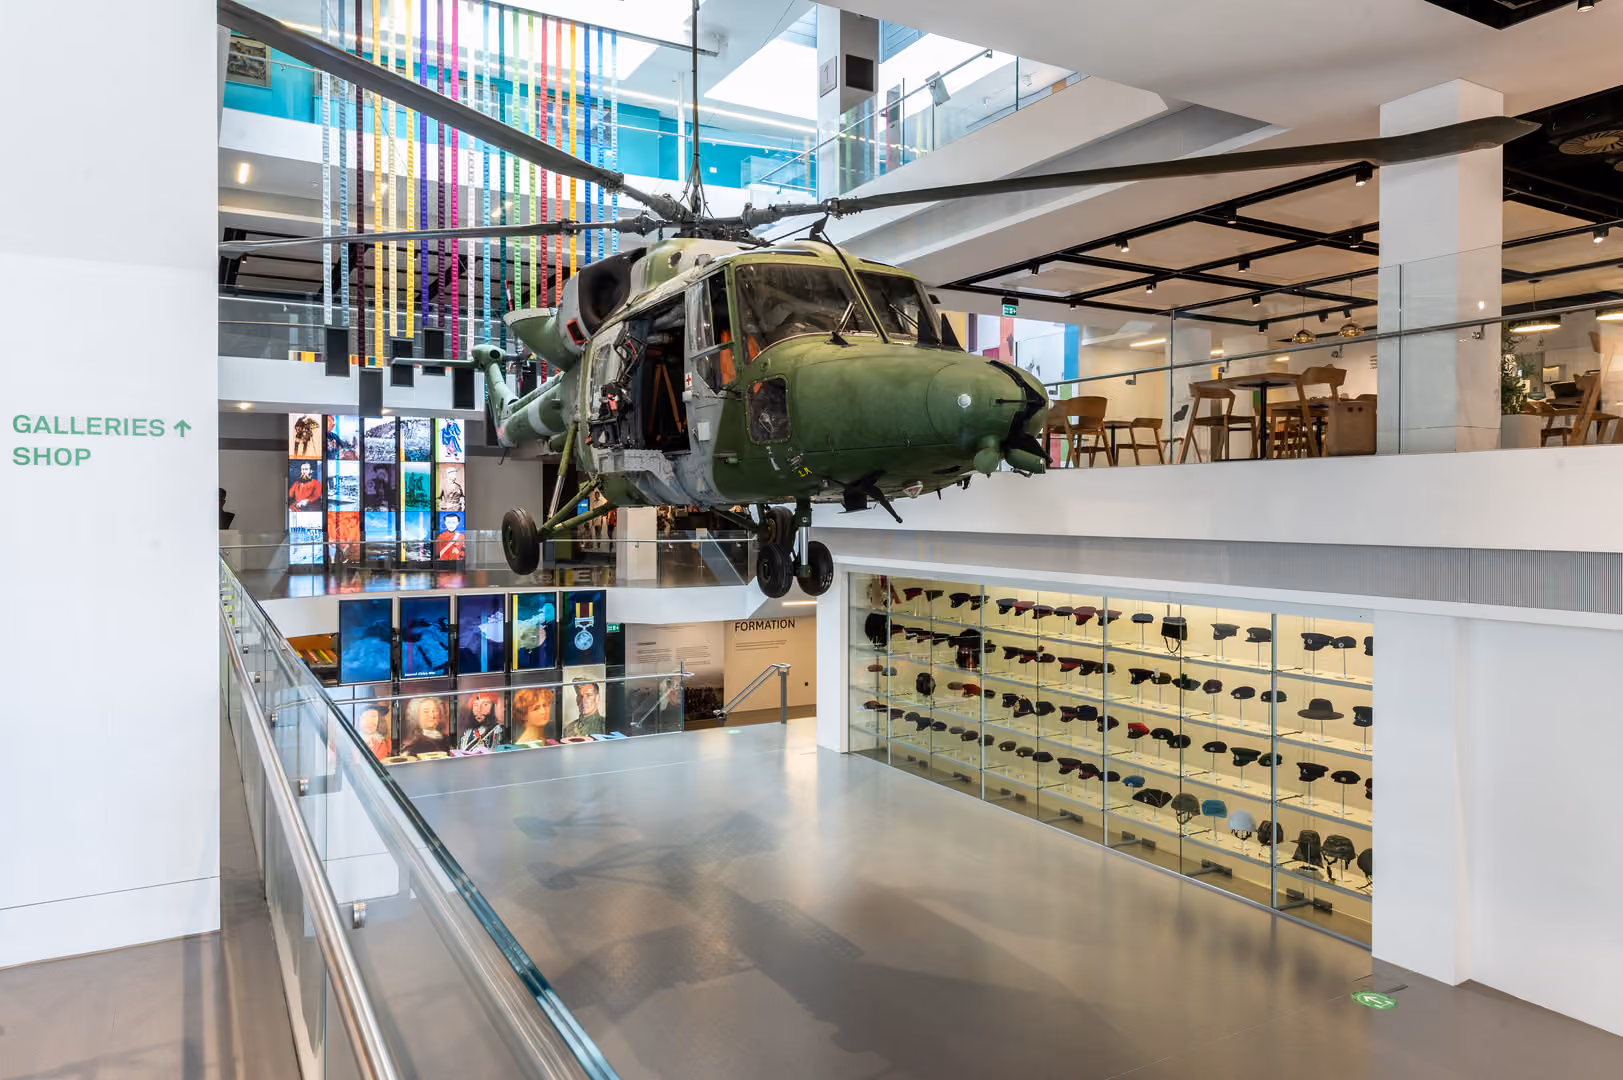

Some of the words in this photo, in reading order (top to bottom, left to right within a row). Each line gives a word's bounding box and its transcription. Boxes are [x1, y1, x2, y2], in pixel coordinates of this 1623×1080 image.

[13, 415, 165, 437] GALLERIES
[13, 447, 91, 466] SHOP
[735, 619, 796, 632] FORMATION
